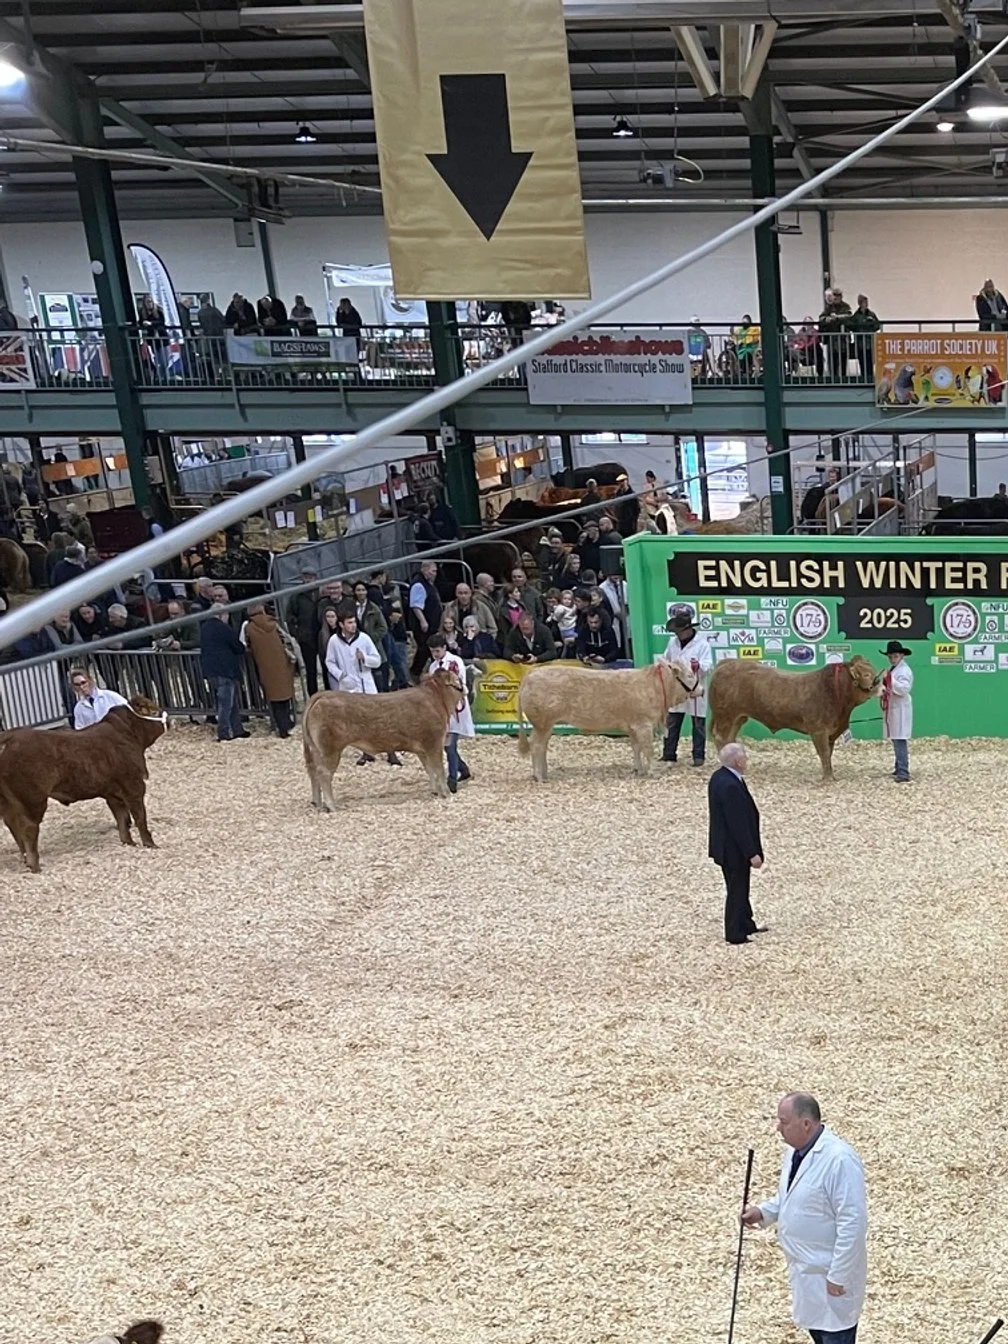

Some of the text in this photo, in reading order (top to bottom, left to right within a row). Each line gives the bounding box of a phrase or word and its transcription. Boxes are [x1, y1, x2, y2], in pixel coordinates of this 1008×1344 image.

[273, 342, 326, 352] BAGSHAWS
[884, 339, 998, 355] THE PARROT SOCIETY UK
[531, 358, 685, 377] Stafford Classic Motorcycle Show
[697, 559, 846, 588] ENGLISH
[855, 560, 988, 589] WINTER
[701, 602, 719, 610] IAE
[769, 599, 788, 607] NFU
[990, 603, 1008, 611] NFU
[799, 613, 823, 628] 175
[859, 607, 912, 628] 2025
[949, 613, 973, 629] 175
[938, 645, 956, 653] IAE
